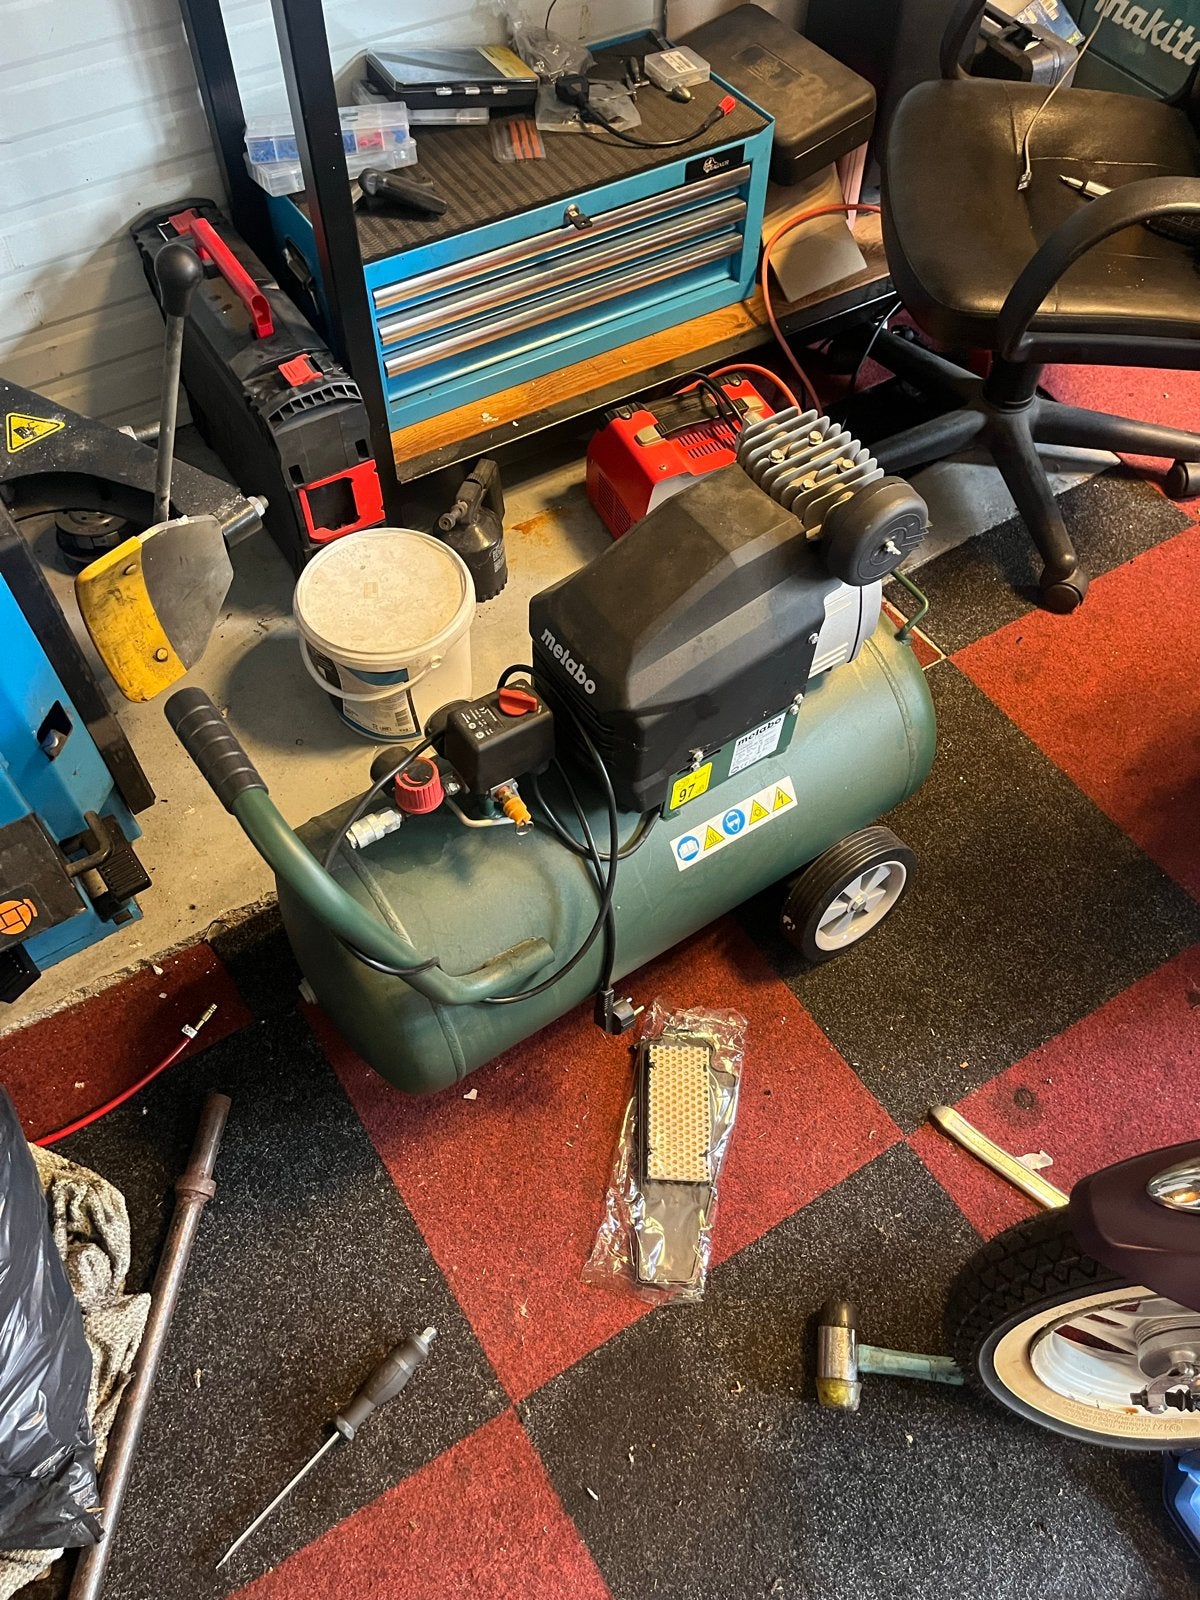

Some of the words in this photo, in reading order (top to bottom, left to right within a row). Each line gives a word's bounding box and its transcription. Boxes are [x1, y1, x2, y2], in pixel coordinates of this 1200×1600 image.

[540, 628, 596, 695] metabo
[737, 717, 782, 746] metabo
[679, 783, 696, 803] 97
